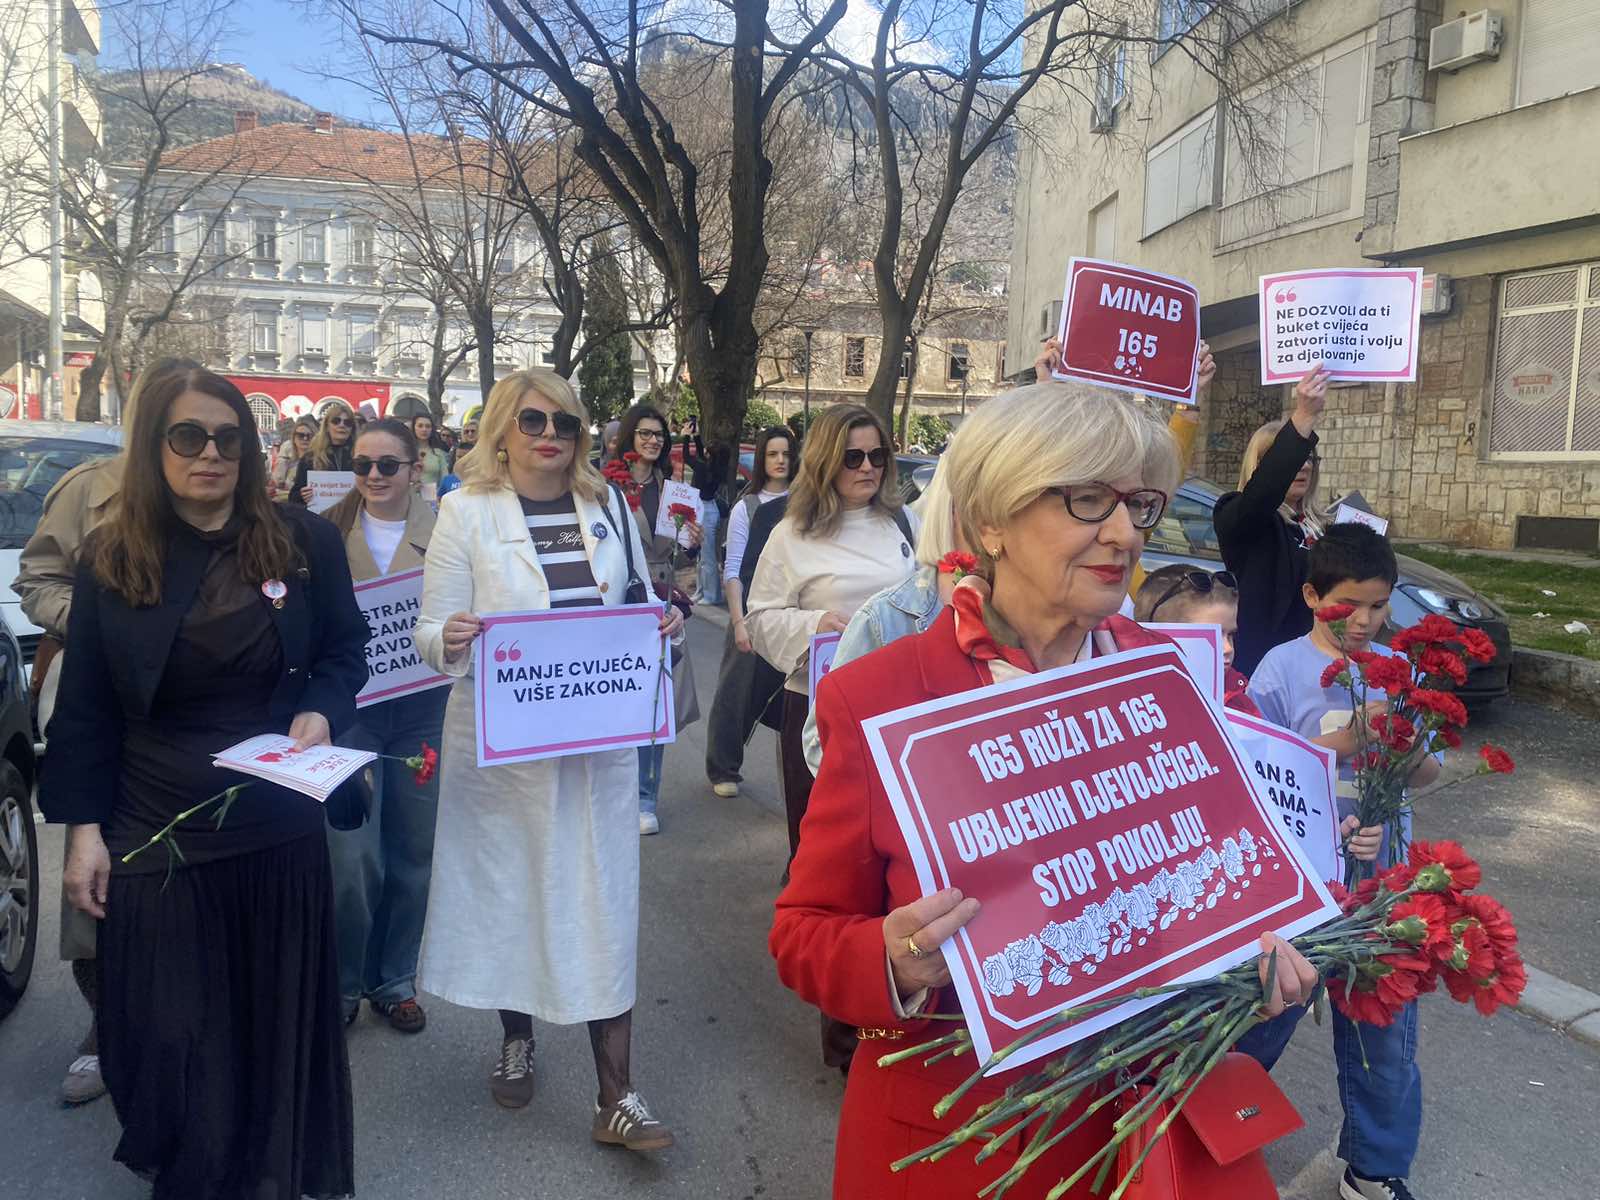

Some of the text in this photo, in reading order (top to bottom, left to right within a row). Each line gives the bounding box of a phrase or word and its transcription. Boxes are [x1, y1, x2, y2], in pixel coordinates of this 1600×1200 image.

[1100, 283, 1183, 322] MINAB
[1276, 305, 1390, 320] NE DOZVOLI da ti
[1276, 319, 1369, 334] buket cvijeća
[1118, 328, 1158, 358] 165
[1277, 333, 1403, 349] zatvori usta i volju
[1277, 349, 1366, 364] za djelovanje
[360, 597, 422, 622] STRAH
[369, 616, 419, 639] CAMA
[364, 636, 412, 659] RAVD
[497, 652, 651, 683] MANJE CVIJEĆA,
[513, 677, 642, 703] VIŠE ZAKONA.
[967, 693, 1168, 783] 165 RUŽA ZA 165
[1255, 760, 1301, 791] AN 8.
[948, 741, 1220, 863] UBIJENIH DJEVOJČICA.
[1268, 786, 1308, 817] AMA
[1295, 819, 1306, 838] S
[1032, 805, 1213, 907] STOP POKOLJU!
